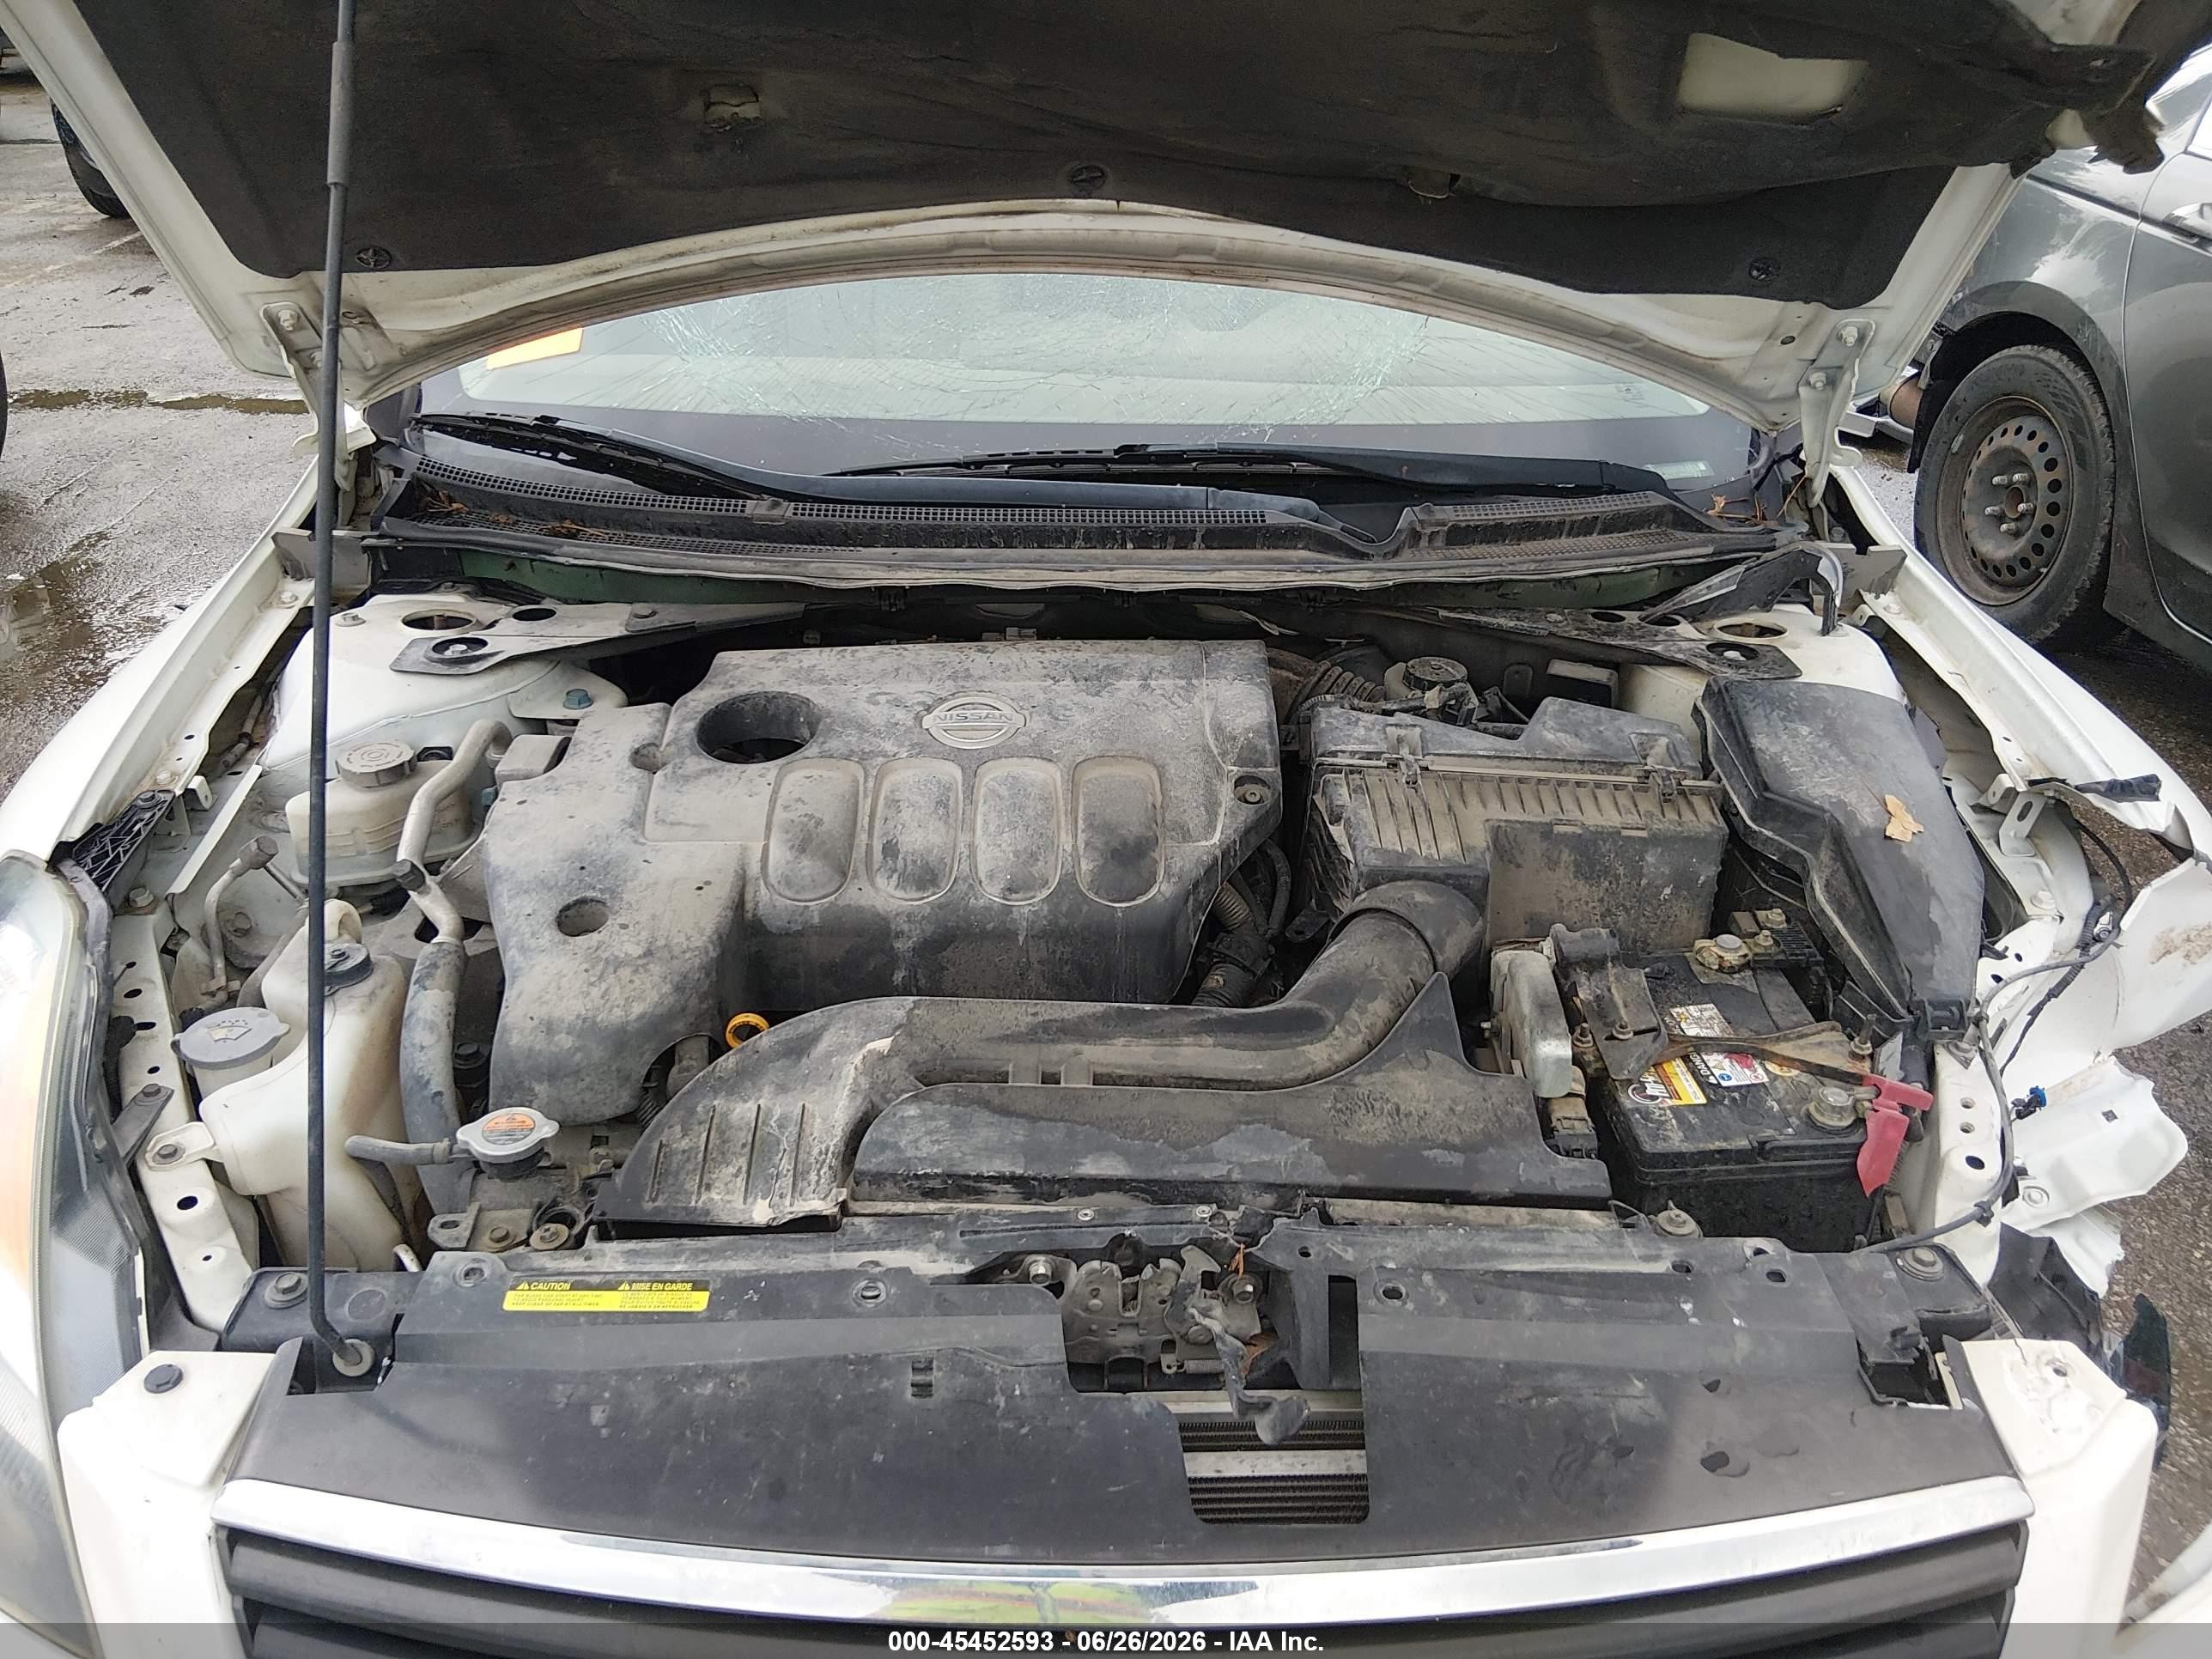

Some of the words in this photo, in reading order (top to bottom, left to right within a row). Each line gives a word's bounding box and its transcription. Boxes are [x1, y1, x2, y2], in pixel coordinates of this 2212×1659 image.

[933, 712, 1013, 722] NISSAN
[530, 1282, 571, 1291] CAUTION
[631, 1282, 652, 1291] MISE
[652, 1282, 665, 1291] EN
[665, 1282, 694, 1291] GARDE
